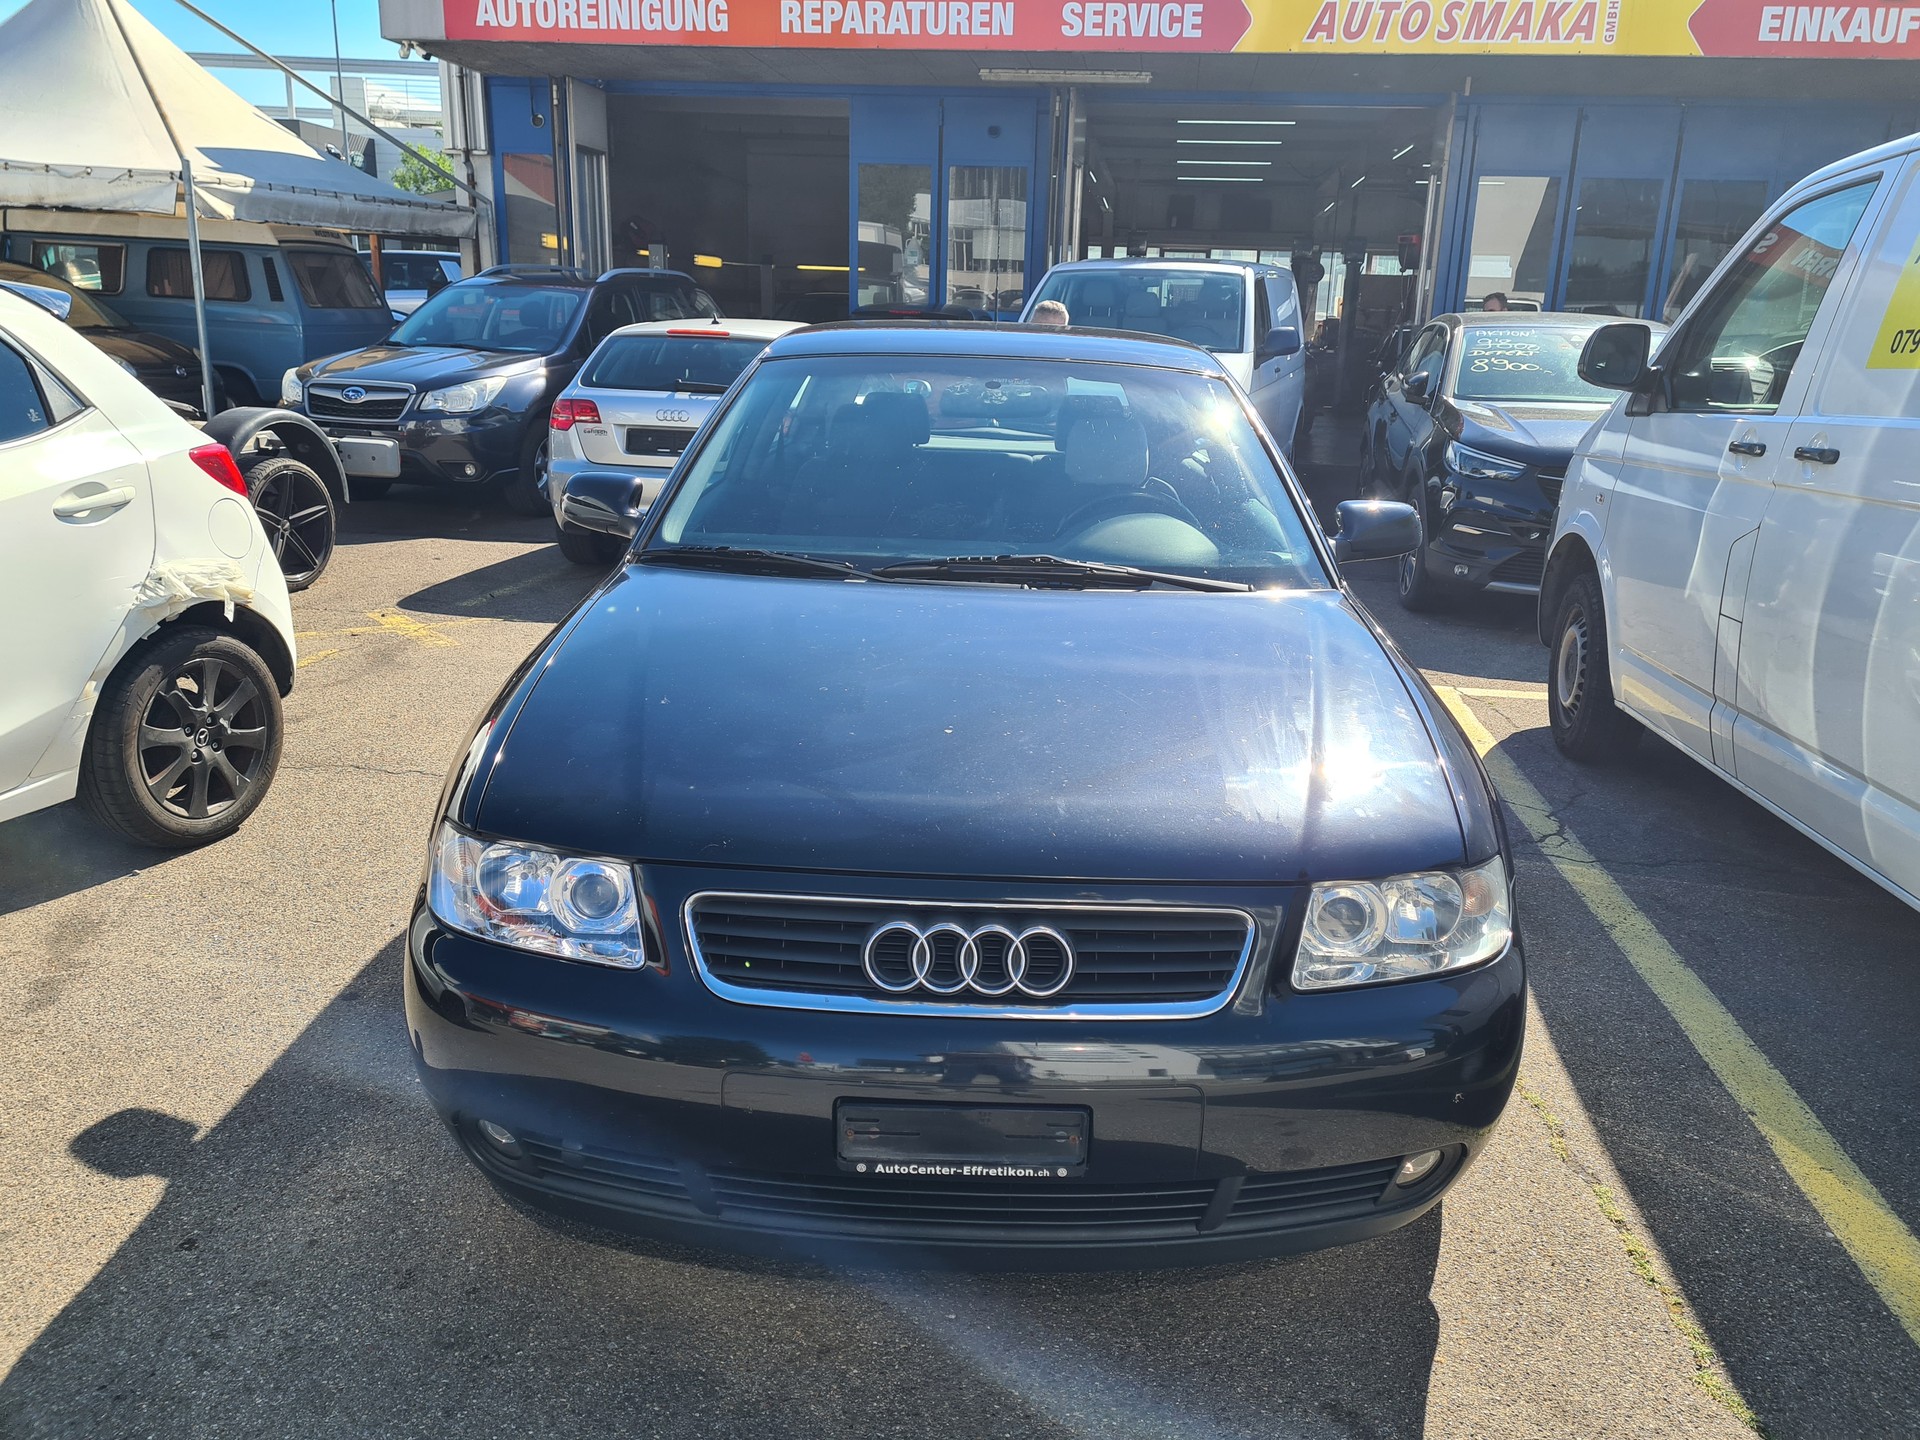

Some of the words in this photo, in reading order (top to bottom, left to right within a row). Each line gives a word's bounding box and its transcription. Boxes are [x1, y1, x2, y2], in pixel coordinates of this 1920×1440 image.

[476, 0, 728, 32] AUTOREINIGUNG
[780, 0, 1014, 36] REPARATUREN
[1060, 2, 1203, 38] SERVICE
[1302, 0, 1426, 43] AUTO
[1434, 0, 1598, 43] SMAKA
[1758, 6, 1920, 44] EINKAUF
[875, 1163, 1050, 1177] AutoCenter-Effretikon.ch
